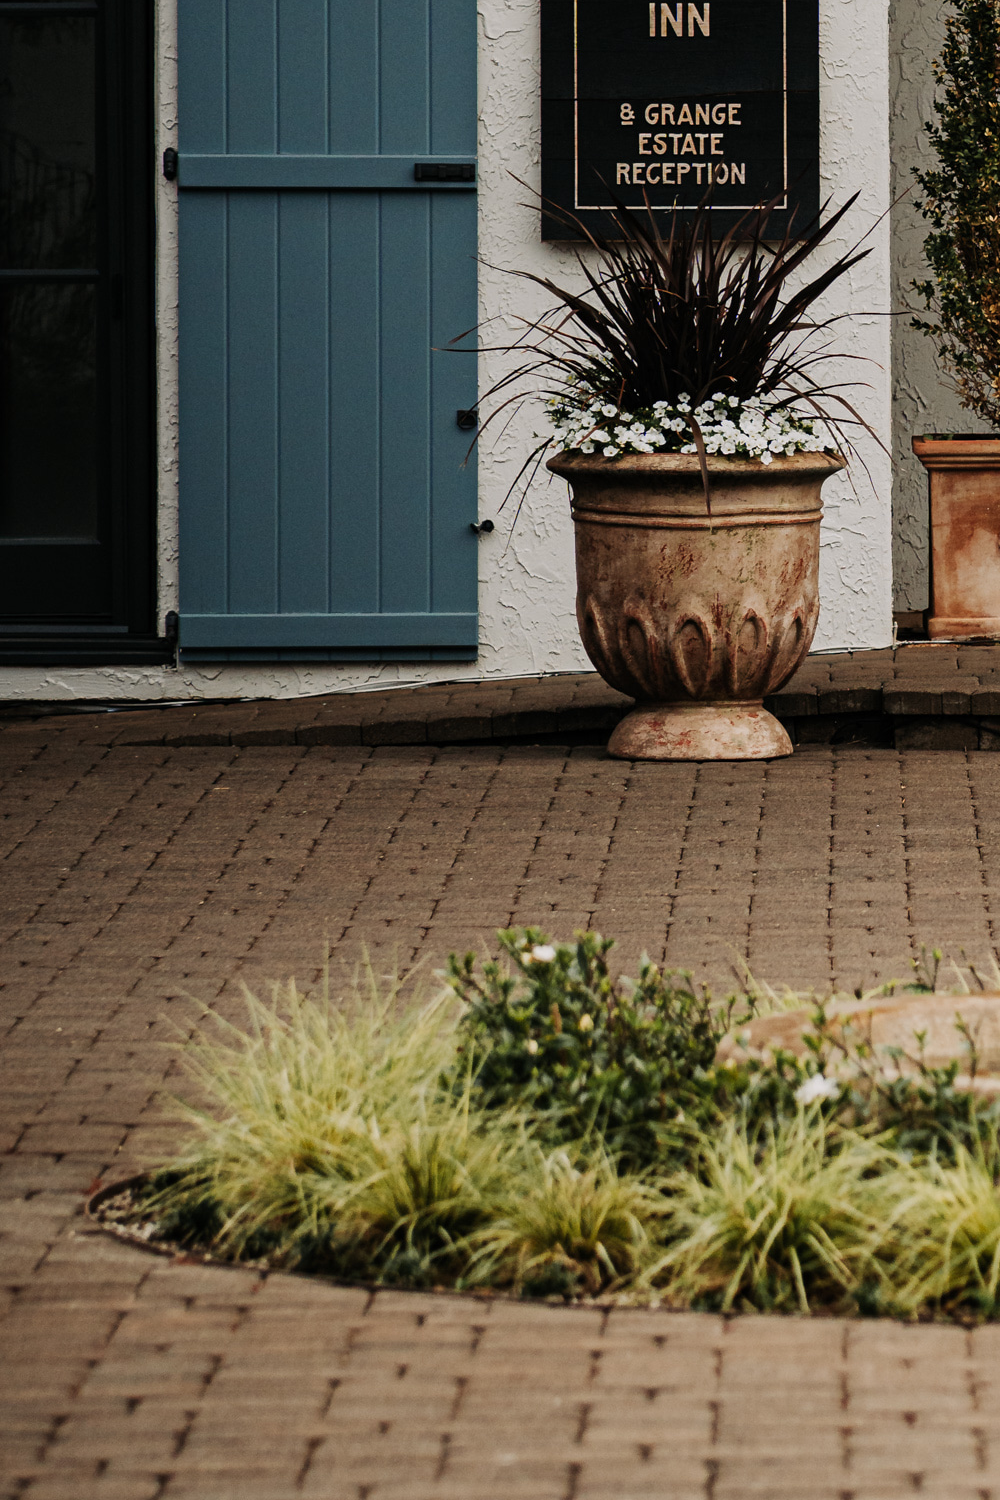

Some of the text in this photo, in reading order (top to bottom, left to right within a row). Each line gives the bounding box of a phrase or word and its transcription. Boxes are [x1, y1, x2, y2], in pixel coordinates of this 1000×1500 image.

[649, 3, 709, 36] INN
[620, 103, 741, 125] & GRANGE
[639, 133, 723, 154] ESTATE
[617, 163, 745, 184] RECEPTION
